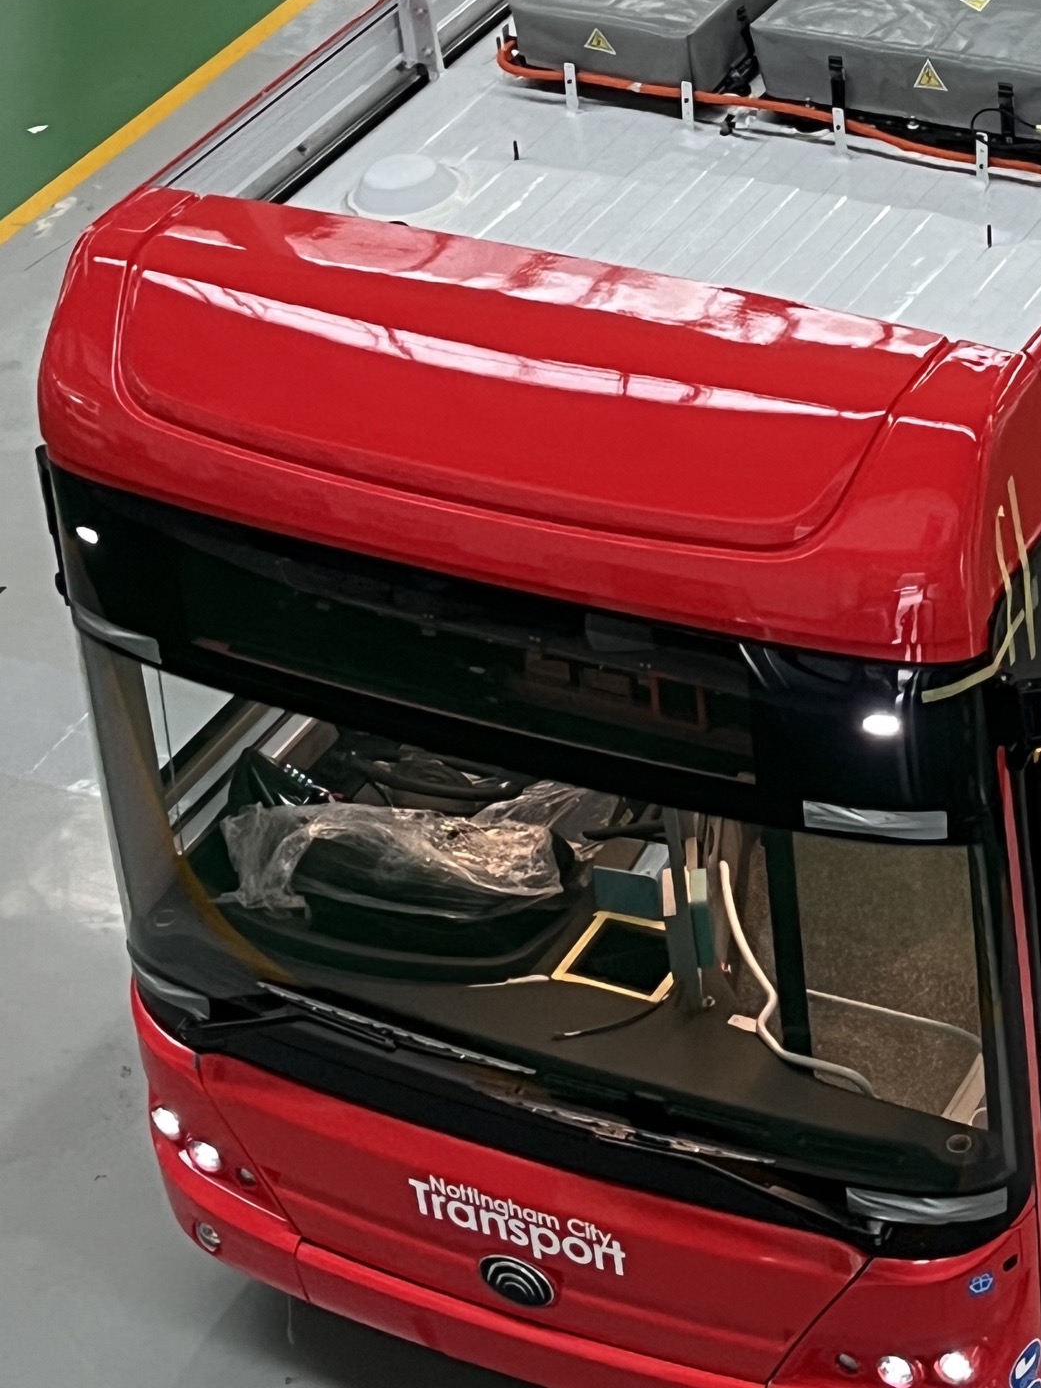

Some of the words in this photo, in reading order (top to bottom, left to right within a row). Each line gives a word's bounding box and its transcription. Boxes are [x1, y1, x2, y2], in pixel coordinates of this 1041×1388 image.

[408, 1178, 626, 1276] Transport
[429, 1174, 560, 1231] Nottingham
[567, 1218, 612, 1248] City
